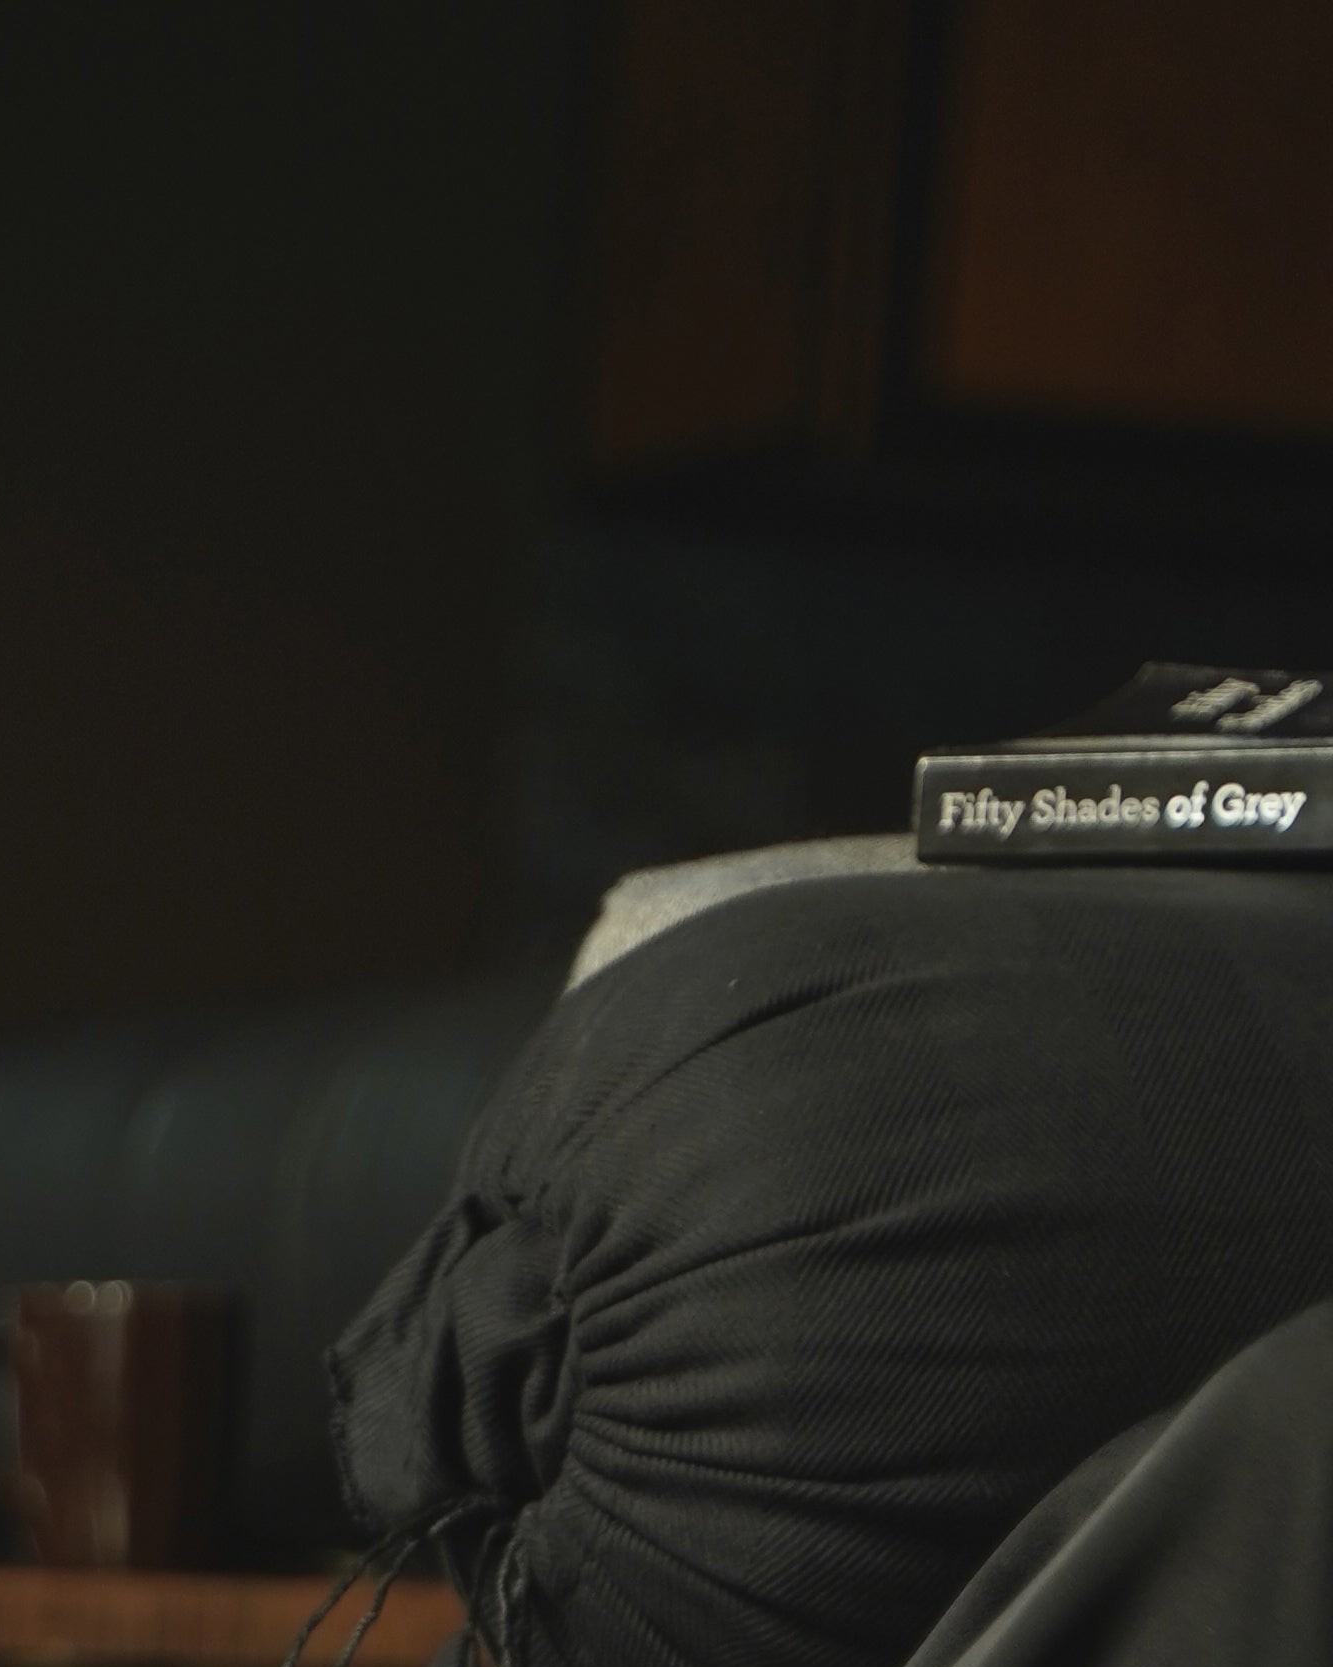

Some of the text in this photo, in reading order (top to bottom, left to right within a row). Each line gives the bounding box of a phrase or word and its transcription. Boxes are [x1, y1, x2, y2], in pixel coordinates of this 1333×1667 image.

[939, 780, 1307, 841] Fifty Shades of Grey
